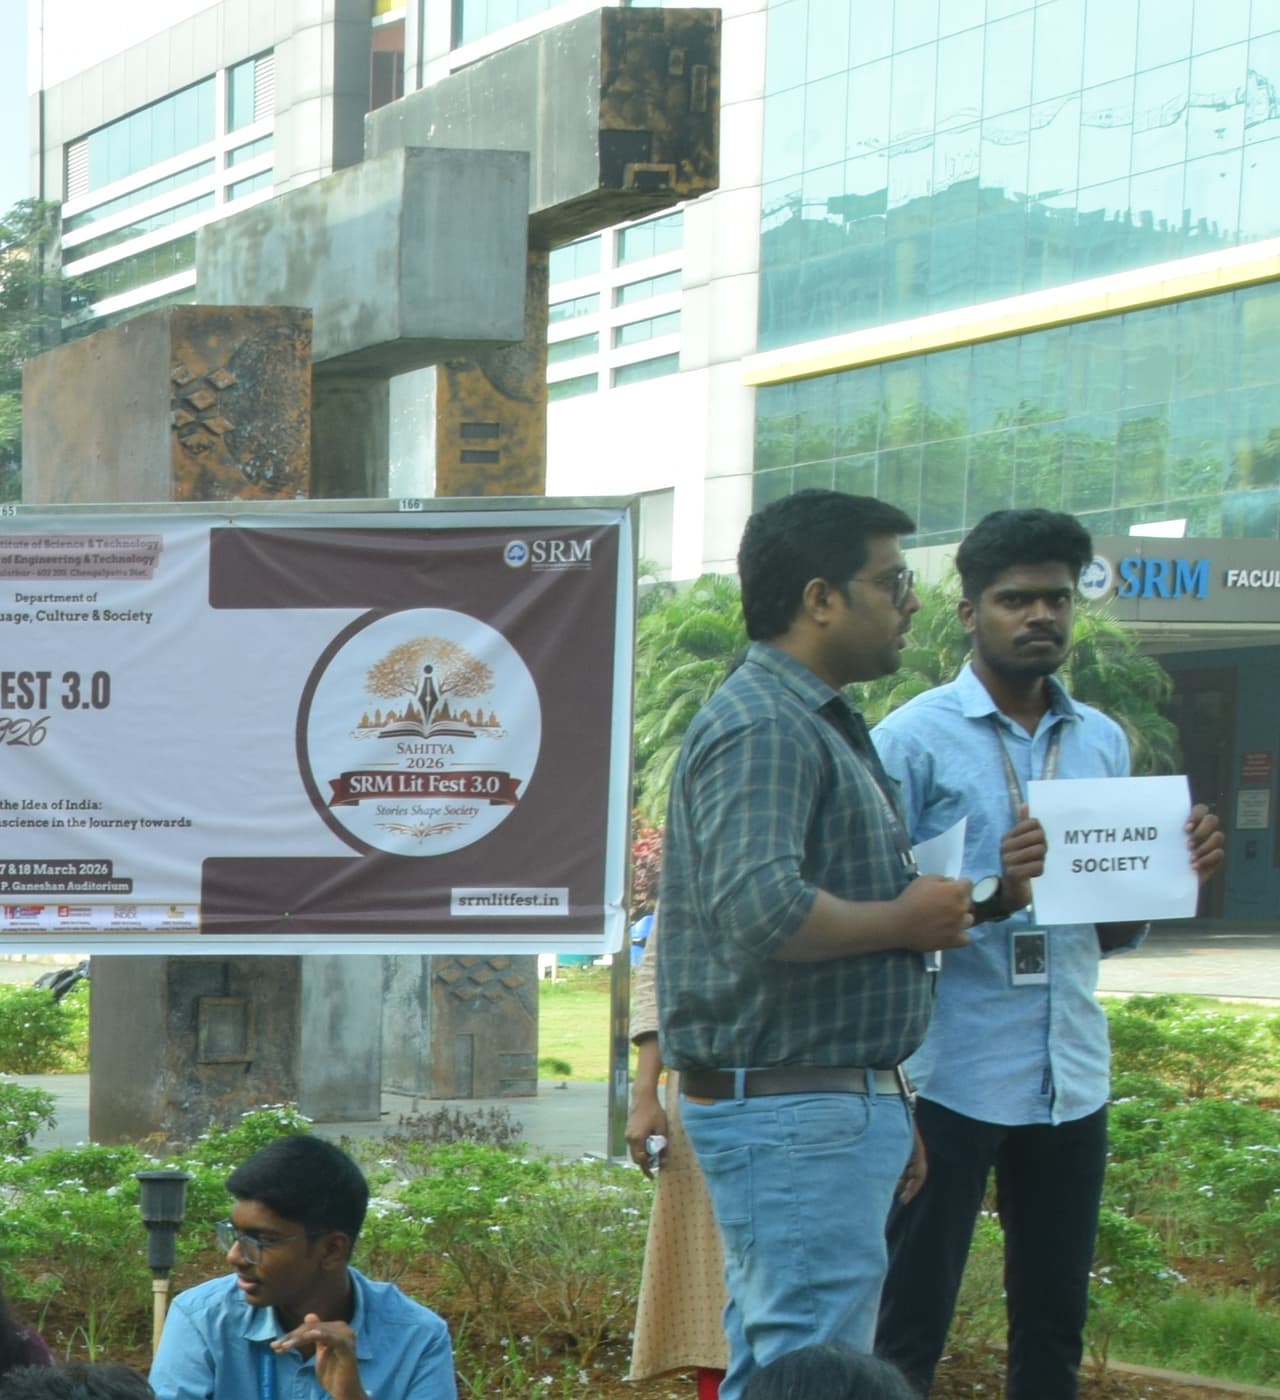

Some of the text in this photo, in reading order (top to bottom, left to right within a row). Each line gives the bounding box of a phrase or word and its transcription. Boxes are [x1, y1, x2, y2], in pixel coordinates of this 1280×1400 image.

[402, 500, 420, 509] 166
[531, 540, 592, 562] SRM
[14, 553, 80, 567] Engineering
[91, 553, 154, 567] Technology
[1117, 557, 1212, 600] SRM
[15, 592, 98, 605] Department of
[35, 609, 89, 622] Culture
[91, 609, 100, 621] &
[102, 609, 153, 624] Society
[61, 671, 111, 710] 3.0
[405, 757, 445, 769] 2026
[349, 775, 501, 794] SRM Lit Fest 3.0
[0, 800, 19, 811] the
[21, 800, 48, 811] Idea
[51, 799, 63, 810] of
[65, 799, 102, 811] India:
[375, 805, 480, 818] Stories Shape Society
[52, 817, 65, 828] in
[67, 817, 87, 828] the
[89, 817, 138, 830] Journey
[140, 817, 192, 828] towards
[1064, 826, 1159, 845] MYTH AND
[8, 864, 18, 875] &
[18, 864, 32, 875] 18
[33, 864, 77, 875] March
[79, 864, 108, 875] 2026
[1071, 856, 1151, 873] SOCIETY
[0, 882, 10, 891] P.
[12, 882, 65, 891] Ganeshan
[66, 882, 129, 891] Auditorium
[458, 893, 560, 906] srmlitfest.in
